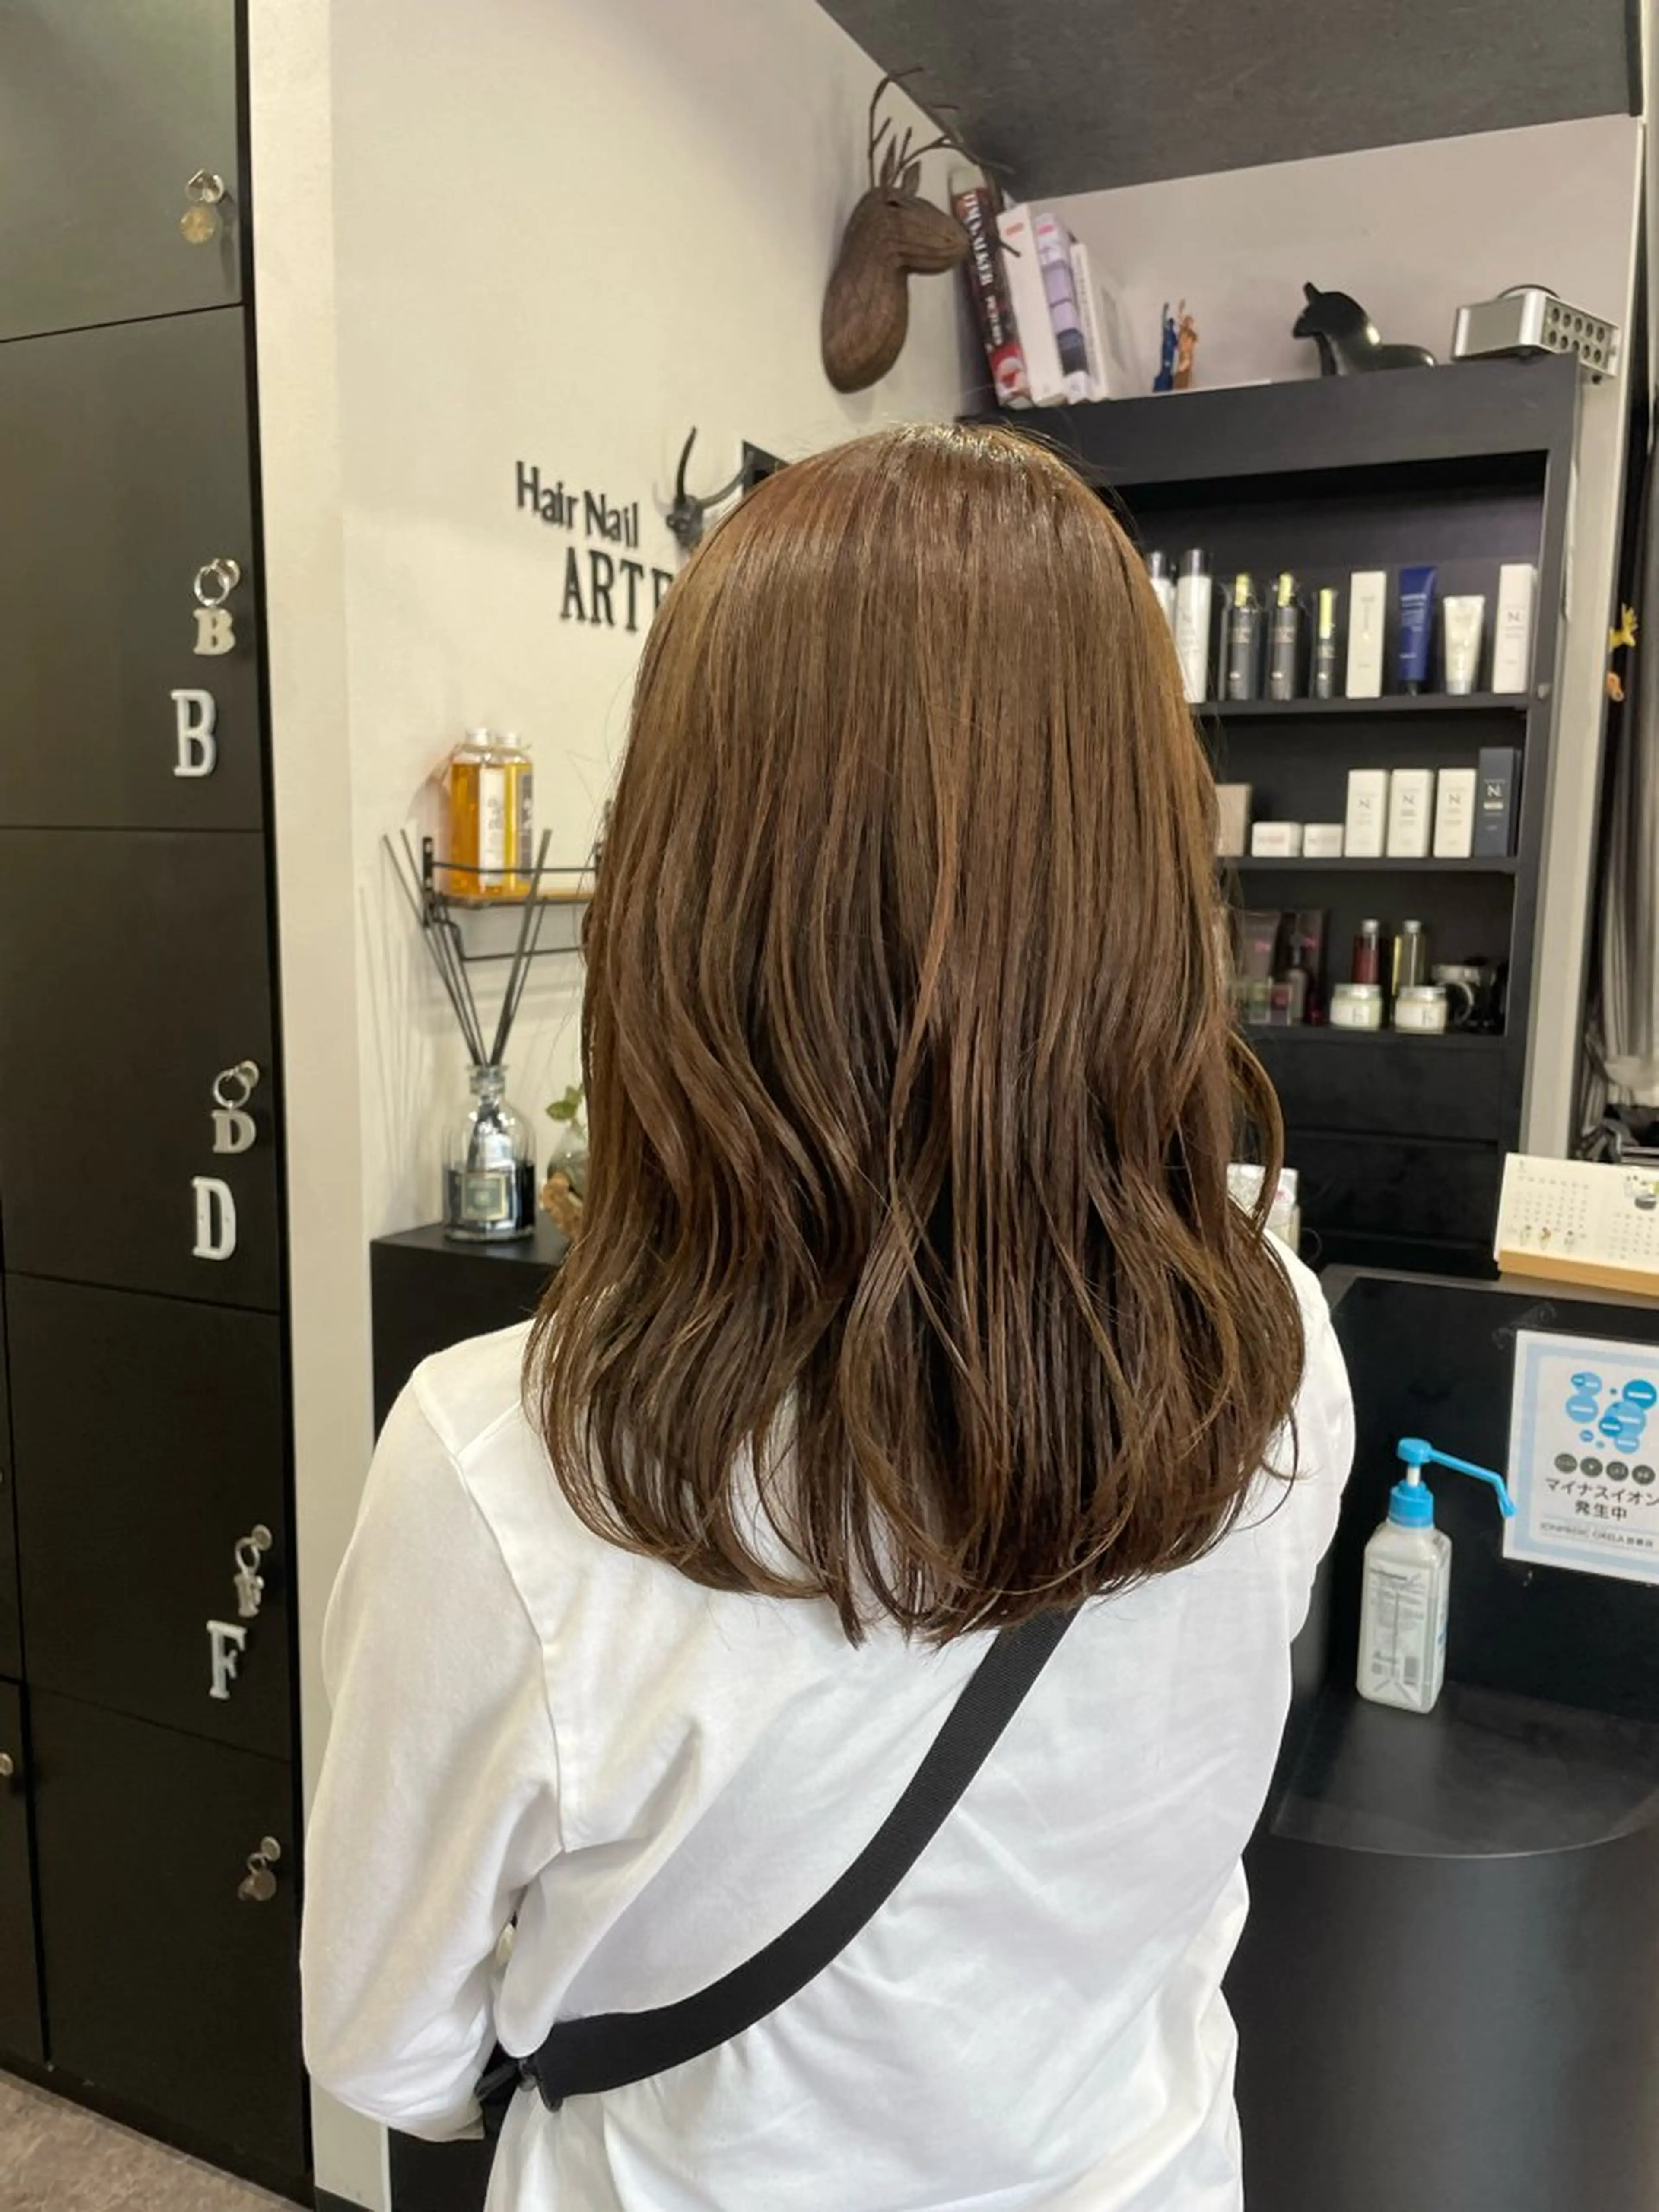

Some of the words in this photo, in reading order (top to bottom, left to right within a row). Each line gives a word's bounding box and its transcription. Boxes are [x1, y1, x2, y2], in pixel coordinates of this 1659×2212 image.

[516, 460, 578, 530] Hair
[583, 490, 639, 548] Nail
[193, 607, 236, 655] B
[171, 689, 216, 777] B
[211, 1109, 256, 1154] D
[191, 1176, 237, 1261] D
[1545, 1477, 1659, 1506] マイナスイオン
[1575, 1500, 1627, 1521] 発生中
[206, 1619, 247, 1700] F
